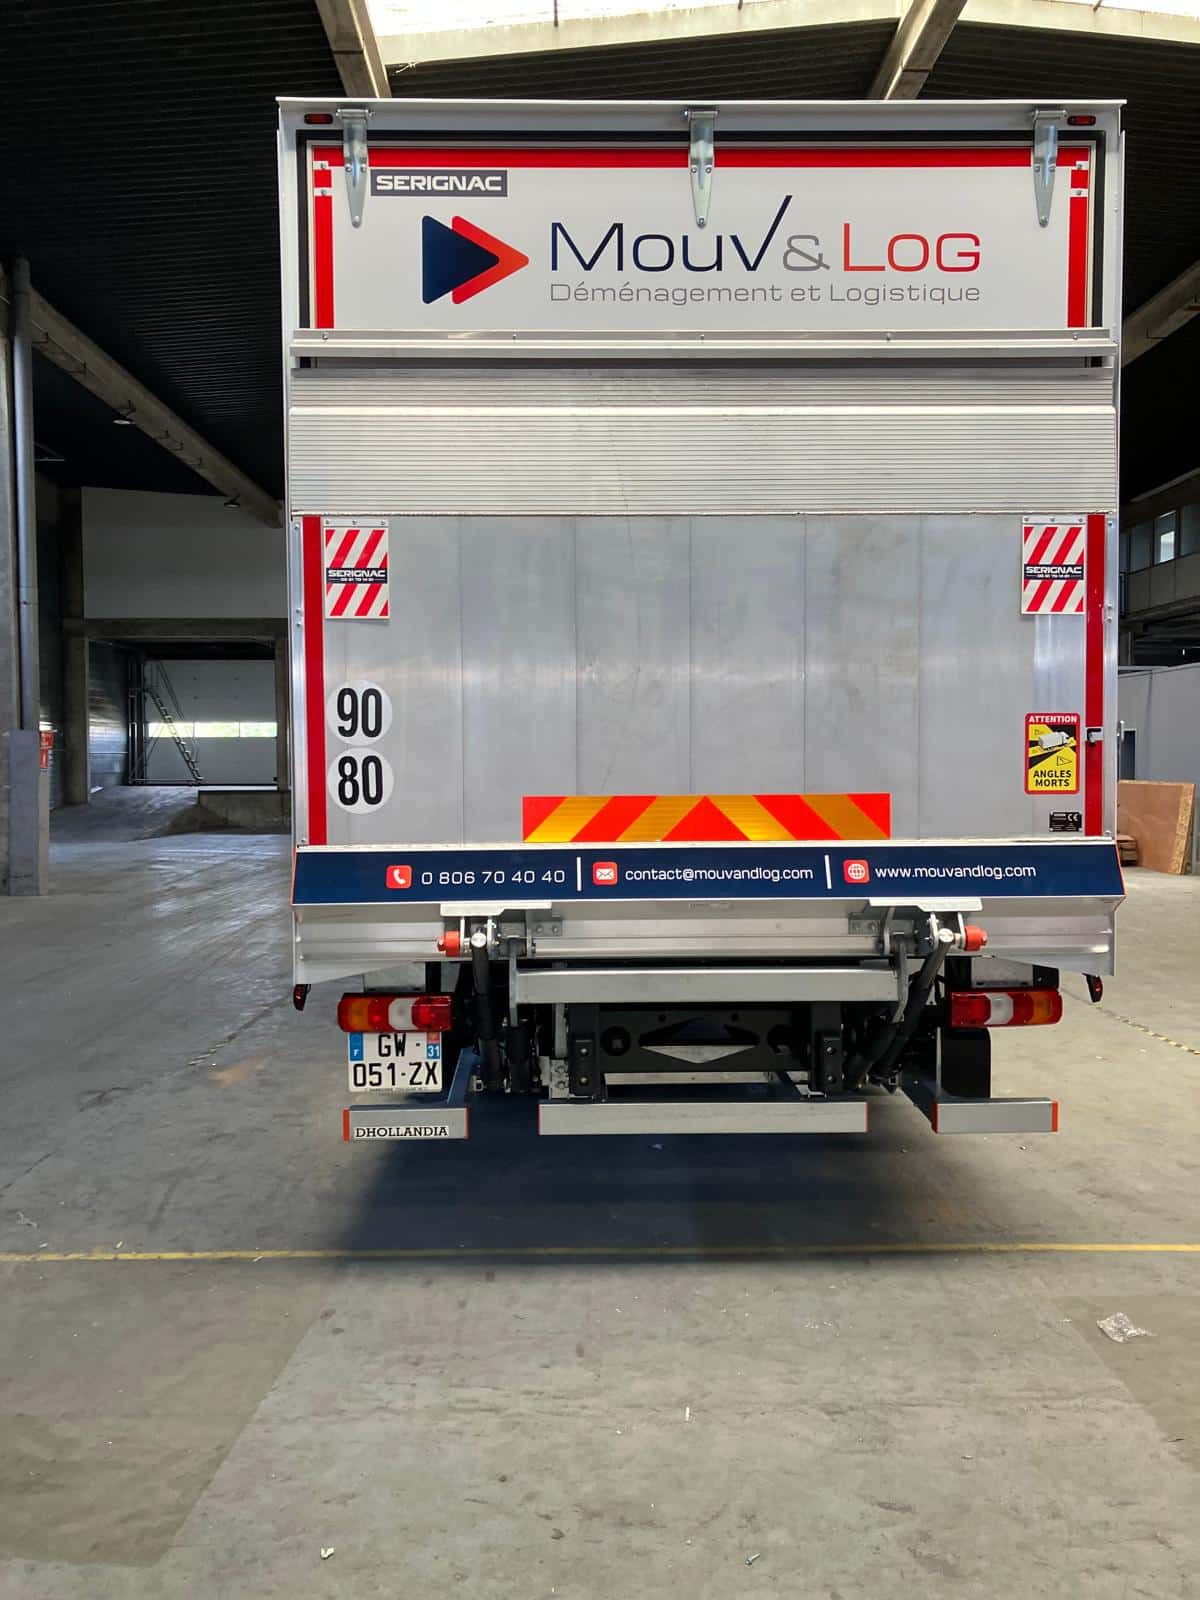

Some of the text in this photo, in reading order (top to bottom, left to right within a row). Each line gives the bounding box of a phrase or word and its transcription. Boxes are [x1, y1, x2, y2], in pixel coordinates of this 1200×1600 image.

[376, 175, 502, 191] SERIGNAC
[550, 280, 980, 306] Déménagement et Logistique
[327, 569, 386, 578] SERIGNAC
[1025, 566, 1082, 574] SERIGNAC
[336, 687, 383, 738] 90
[1028, 715, 1077, 723] ATTENTION
[337, 755, 384, 806] 80
[1033, 769, 1072, 778] ANGLES
[1035, 778, 1070, 787] MORTS
[438, 871, 476, 885] 806
[481, 871, 505, 884] 70
[511, 870, 535, 883] 40
[541, 870, 565, 883] 40
[625, 867, 814, 882] contact@mouvandlog.com
[874, 865, 1037, 880] www.mouvandlog.com
[427, 1045, 440, 1057] 31
[353, 1062, 438, 1087] 051-ZX
[355, 1126, 448, 1138] DHOLLANDIA
